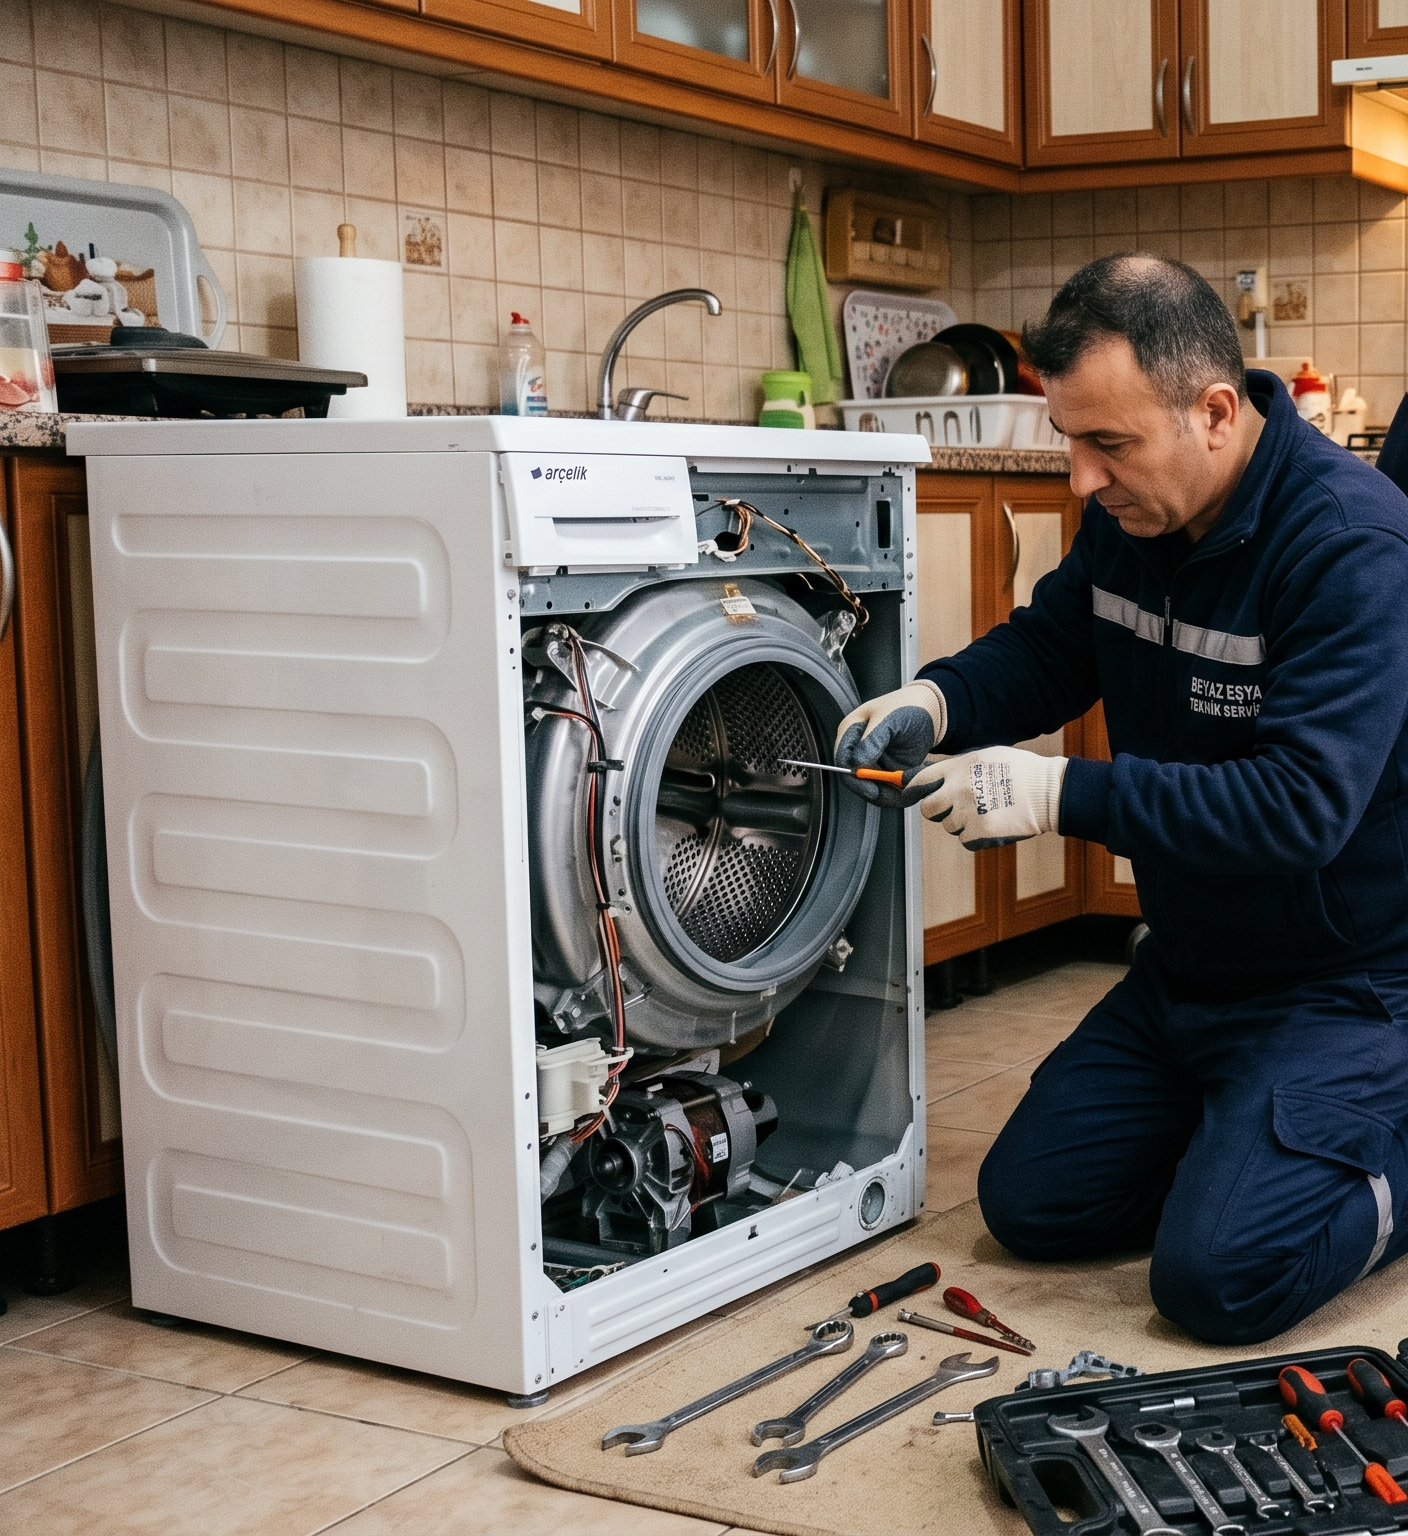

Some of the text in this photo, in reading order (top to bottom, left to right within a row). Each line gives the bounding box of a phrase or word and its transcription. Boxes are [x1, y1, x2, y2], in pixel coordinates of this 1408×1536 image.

[545, 466, 588, 483] arçelik
[1191, 676, 1263, 704] BEYAZ EŞYA
[1189, 697, 1222, 717] TEKNİK
